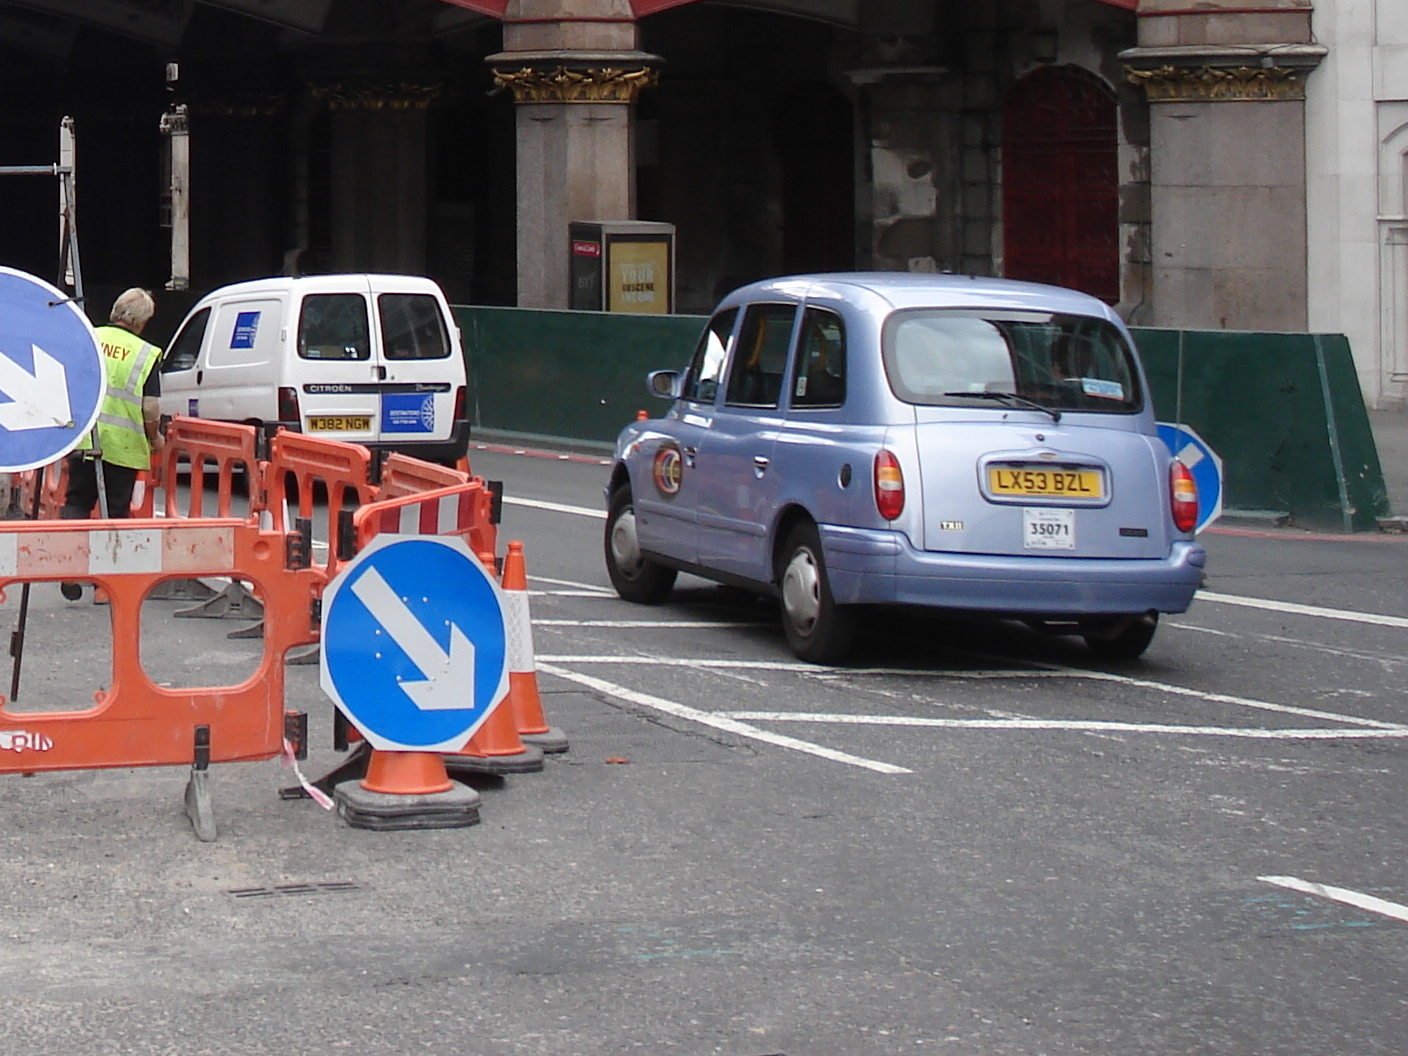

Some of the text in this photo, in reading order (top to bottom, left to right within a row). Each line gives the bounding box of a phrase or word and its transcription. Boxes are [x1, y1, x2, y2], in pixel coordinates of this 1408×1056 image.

[101, 342, 131, 361] NEY
[310, 418, 370, 430] W382 NGW
[997, 470, 1091, 491] LX53 BZL
[1030, 522, 1069, 535] 35071
